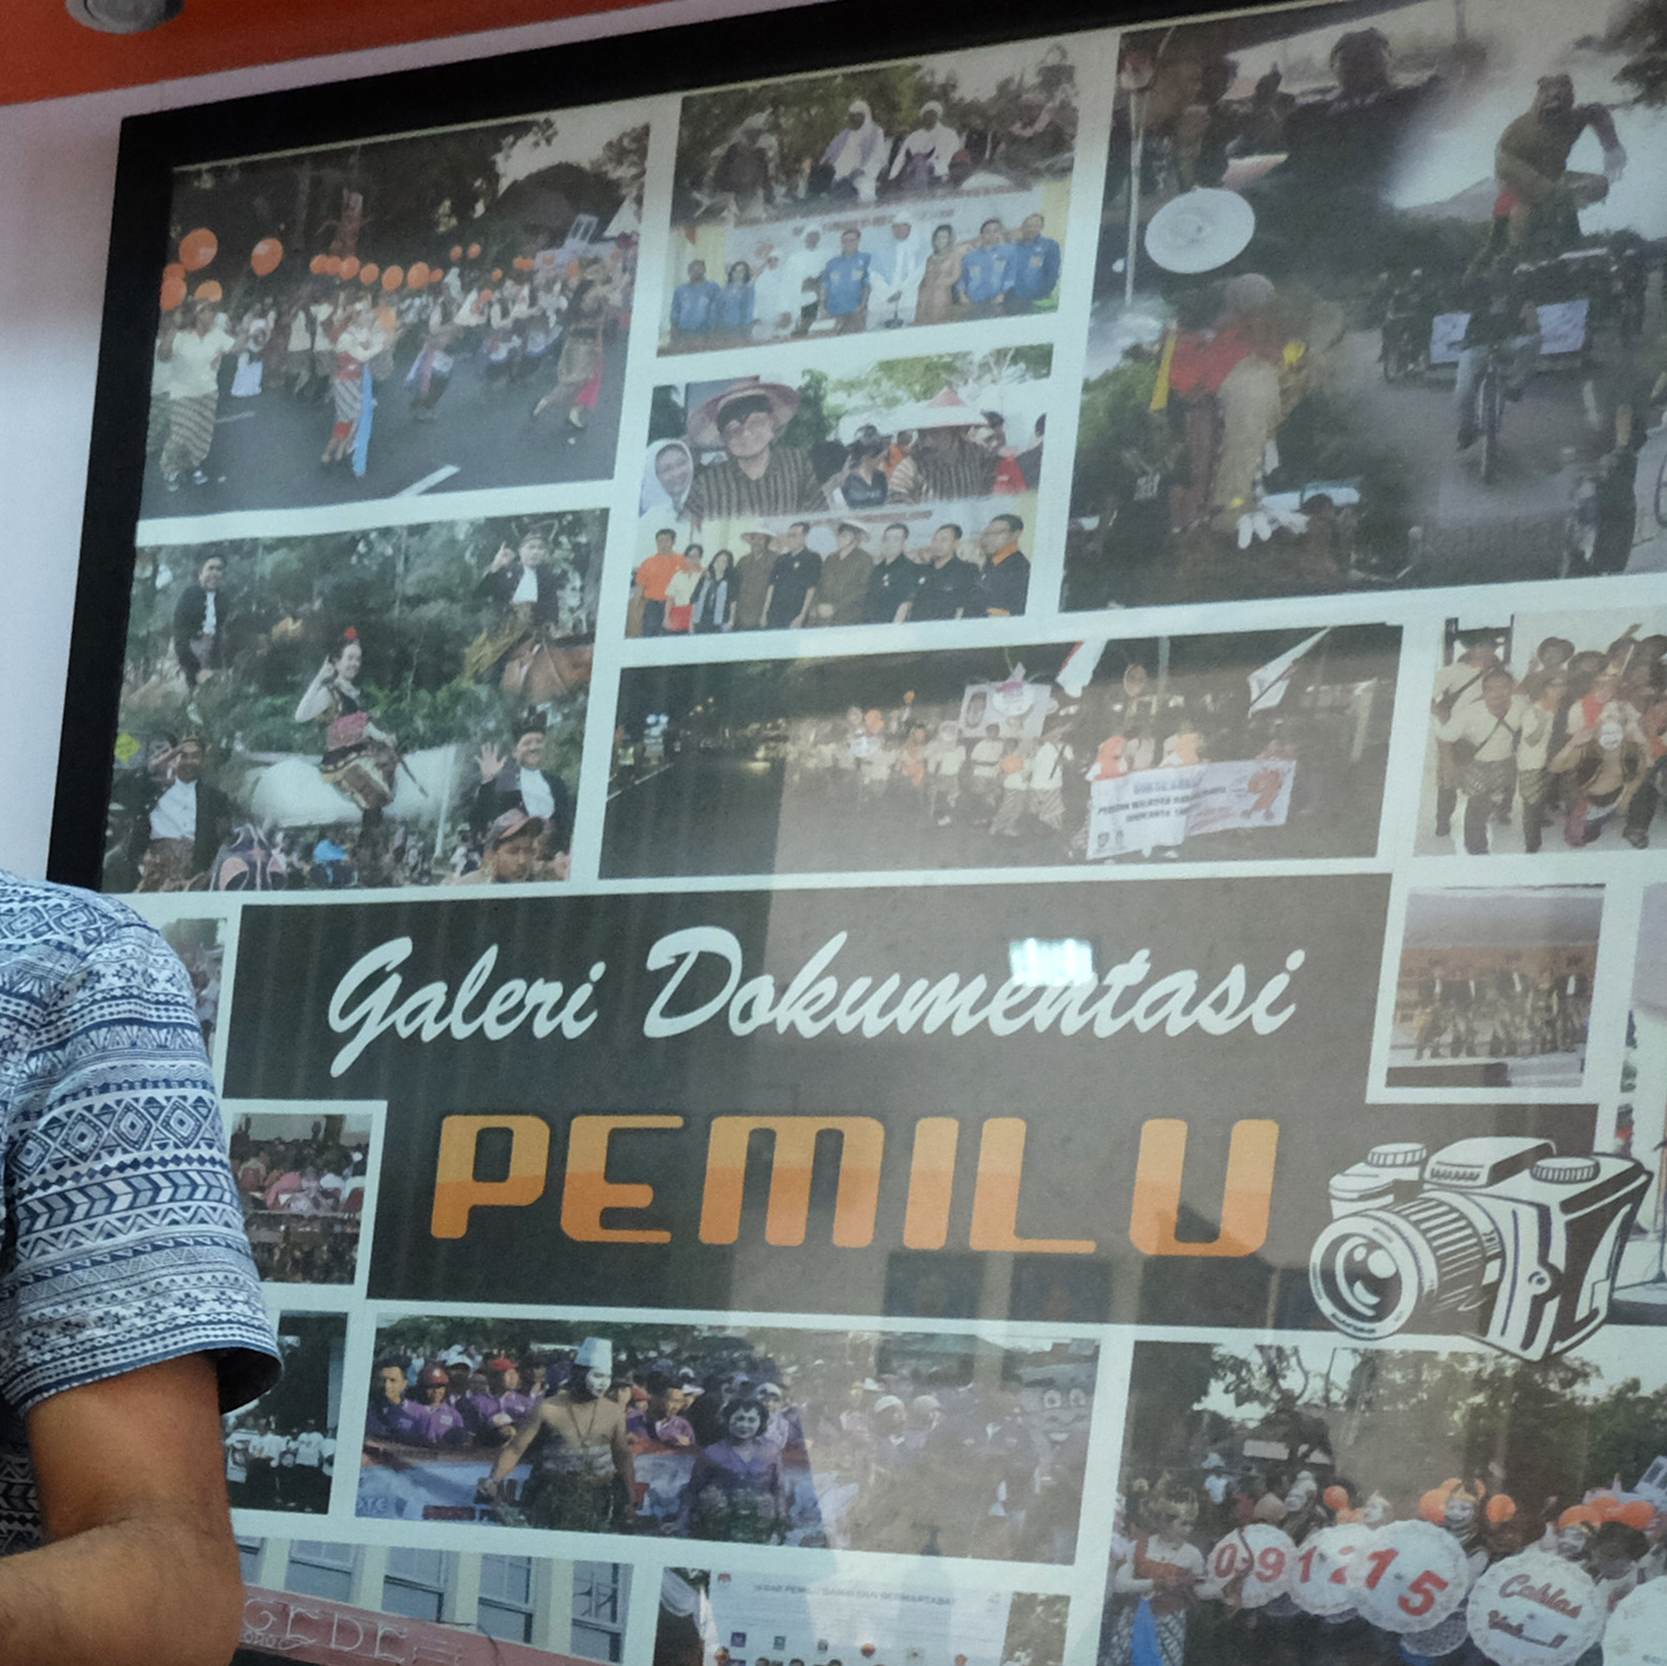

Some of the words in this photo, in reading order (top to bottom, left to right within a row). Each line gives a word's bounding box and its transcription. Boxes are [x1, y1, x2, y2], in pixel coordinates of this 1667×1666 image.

[327, 936, 606, 1078] Galeri
[643, 925, 1308, 1039] Dokumentasi
[430, 1113, 1280, 1258] PEMILU
[1364, 1547, 1450, 1618] 15
